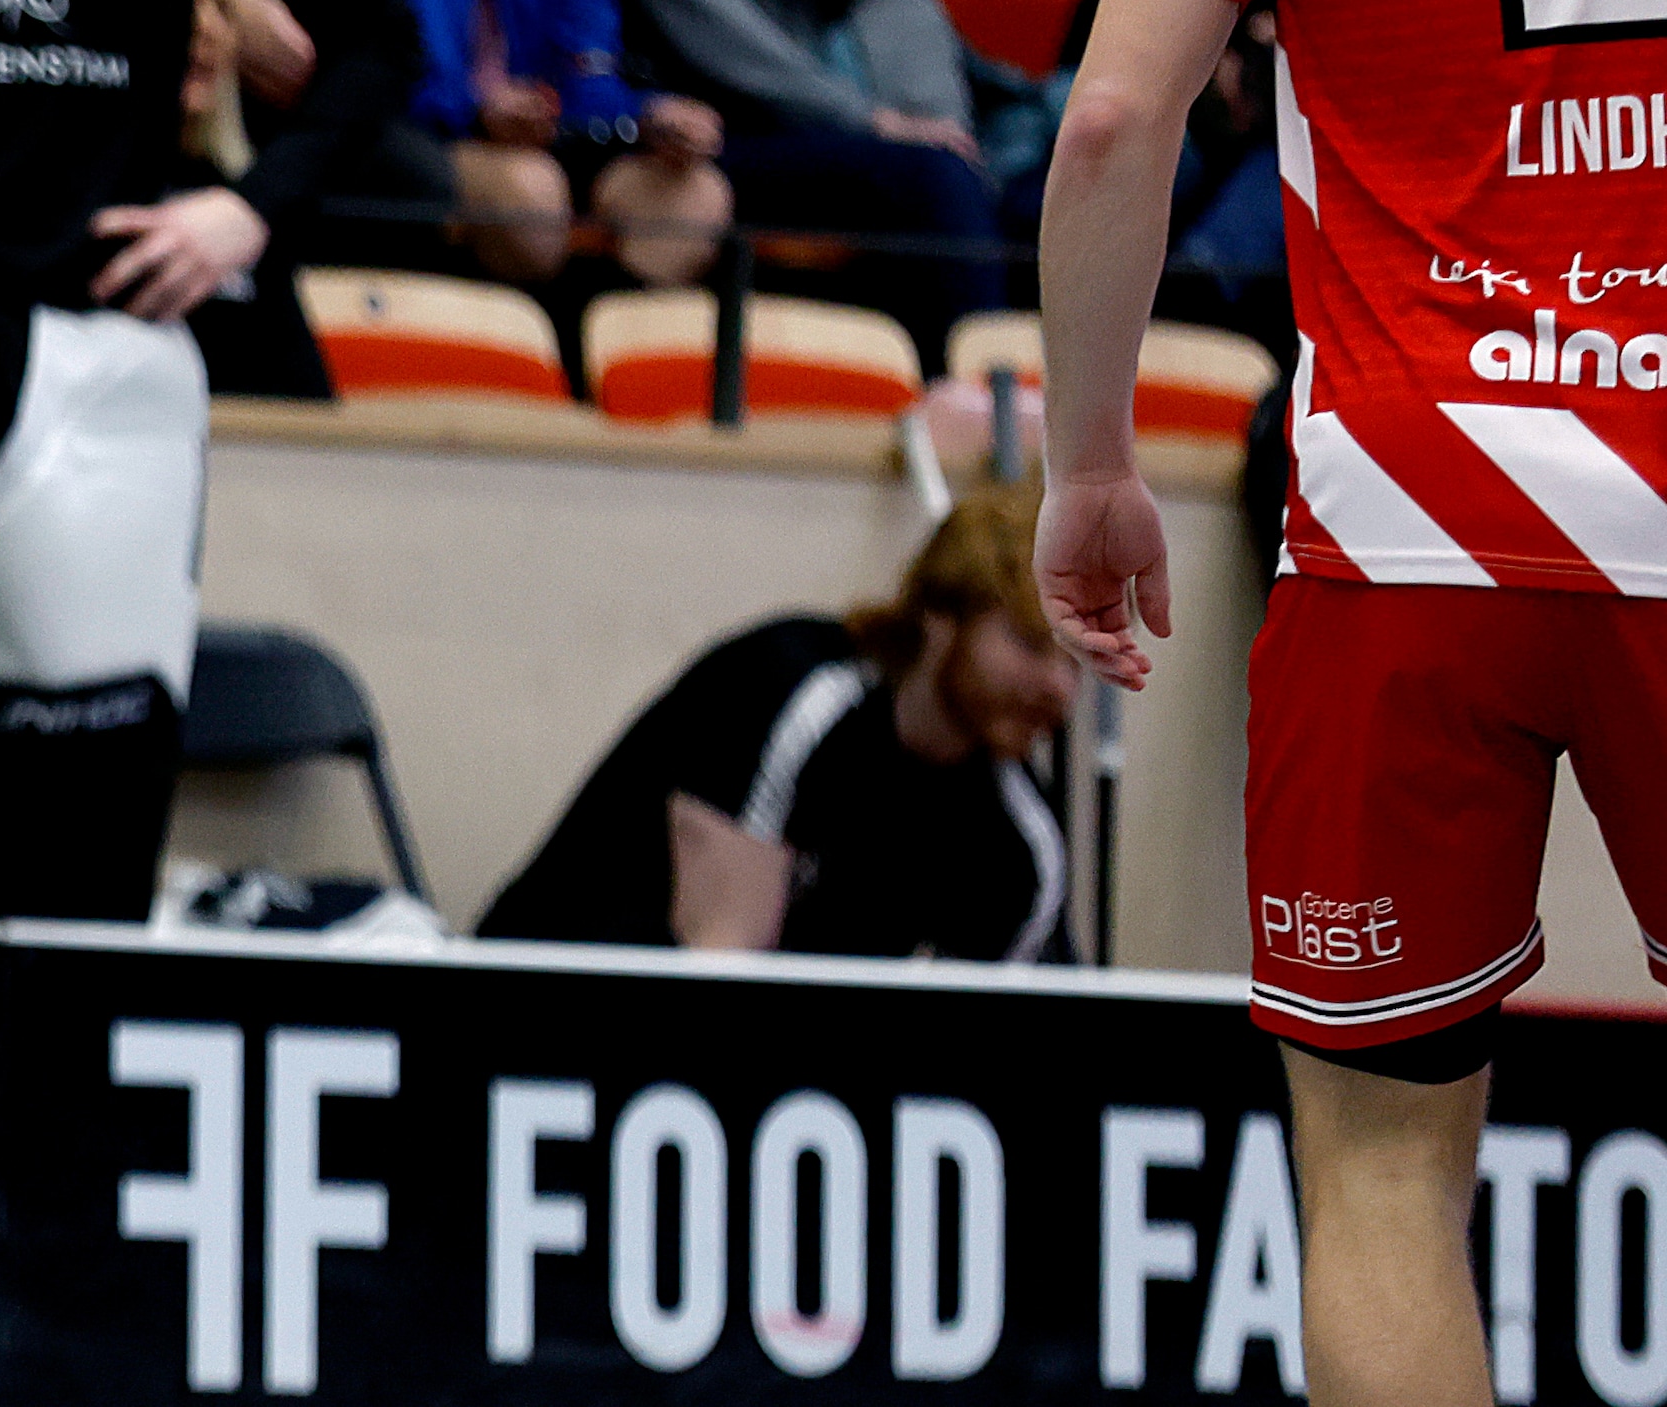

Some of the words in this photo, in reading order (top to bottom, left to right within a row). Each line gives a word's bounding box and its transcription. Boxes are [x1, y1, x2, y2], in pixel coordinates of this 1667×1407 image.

[1261, 894, 1402, 963] Plast
[1301, 892, 1395, 920] Götene
[487, 1077, 1006, 1383] FOOD
[1099, 1106, 1667, 1405] FATO
